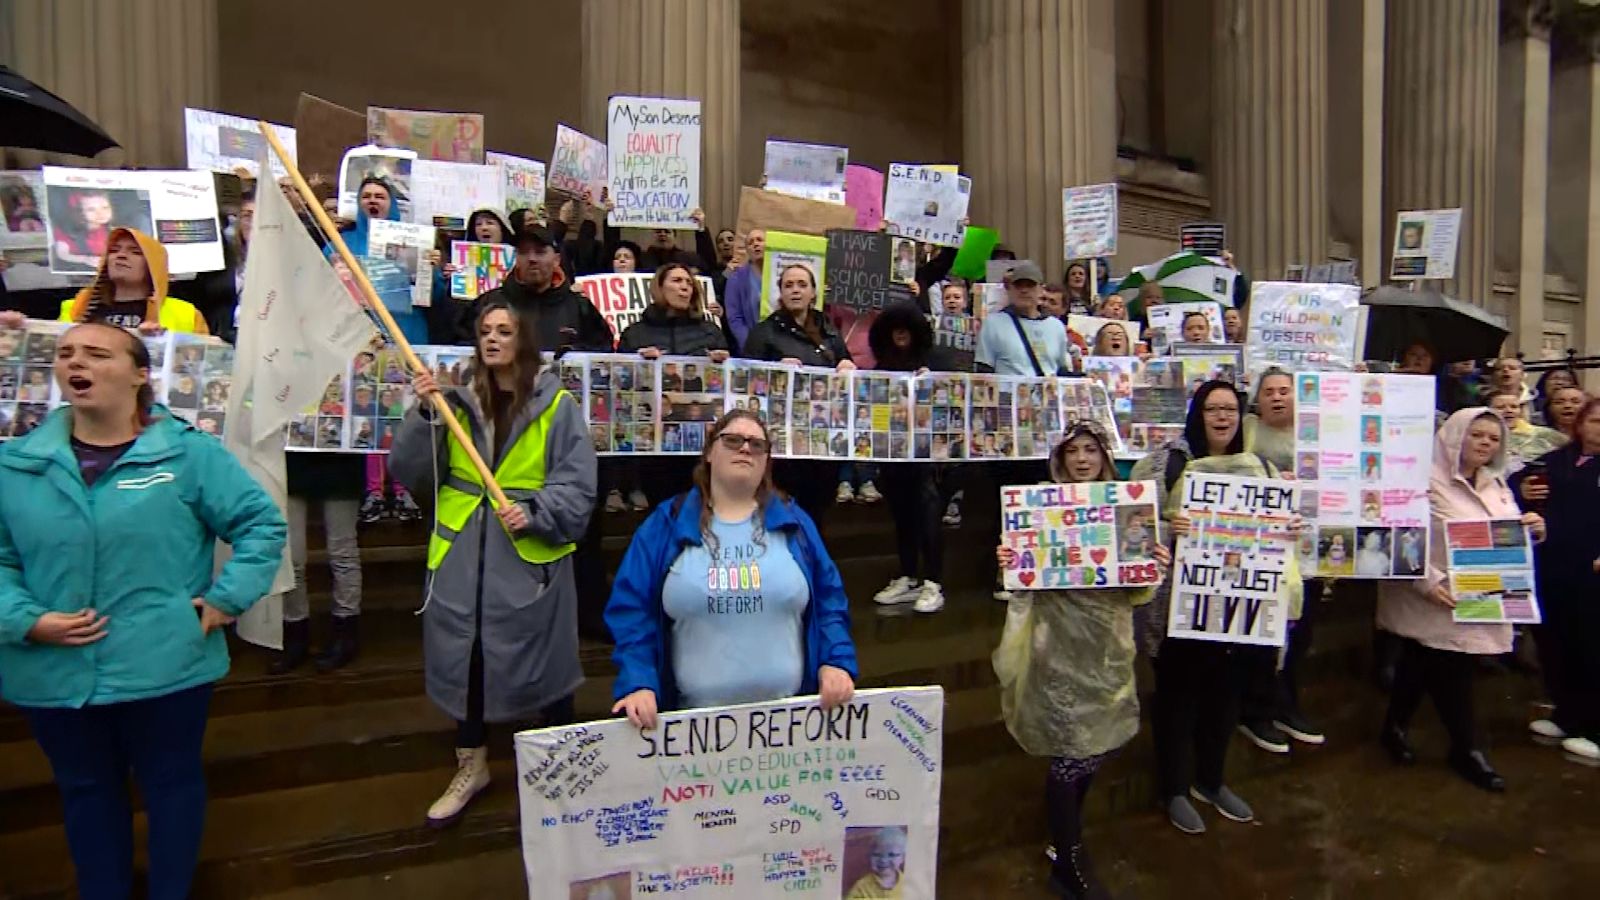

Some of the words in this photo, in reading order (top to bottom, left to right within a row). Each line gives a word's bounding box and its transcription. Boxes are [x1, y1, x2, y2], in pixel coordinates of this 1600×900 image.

[613, 104, 639, 130] My
[640, 104, 660, 124] Son
[627, 133, 682, 155] EQUALITY
[615, 153, 689, 173] HAPPINESS
[617, 191, 690, 209] EDUCATION
[831, 233, 838, 249] I
[842, 232, 878, 252] HAVE
[455, 244, 518, 270] THRIV
[844, 252, 865, 269] NO
[830, 269, 888, 290] SCHOOL
[1260, 311, 1342, 327] CHILDREN
[1004, 489, 1021, 507] I
[1026, 485, 1087, 507] WILL
[1089, 483, 1119, 504] BE
[1190, 480, 1230, 504] LET
[1005, 510, 1045, 531] HIS
[1005, 529, 1065, 549] TILL
[1064, 525, 1111, 548] THE
[1004, 548, 1048, 571] DAY
[1050, 546, 1082, 567] HE
[1042, 567, 1108, 587] FINDS
[1117, 563, 1159, 585] HIS
[1181, 563, 1221, 587] NOT
[1231, 568, 1283, 593] JUST
[707, 594, 764, 615] REFORM
[637, 715, 738, 759] S.E.N.D
[748, 703, 869, 749] REFORM
[658, 756, 754, 782] VALUED
[758, 746, 856, 771] EDUCATION
[721, 774, 791, 796] VALUE
[798, 768, 833, 784] FOR
[764, 793, 791, 806] ASD
[542, 817, 557, 827] NO
[561, 808, 595, 824] EHCP
[694, 808, 736, 821] MENTAL
[701, 816, 737, 829] HEALTH
[768, 819, 801, 834] SPD
[638, 872, 644, 882] I
[783, 878, 822, 892] CHILD
[638, 883, 660, 893] THE
